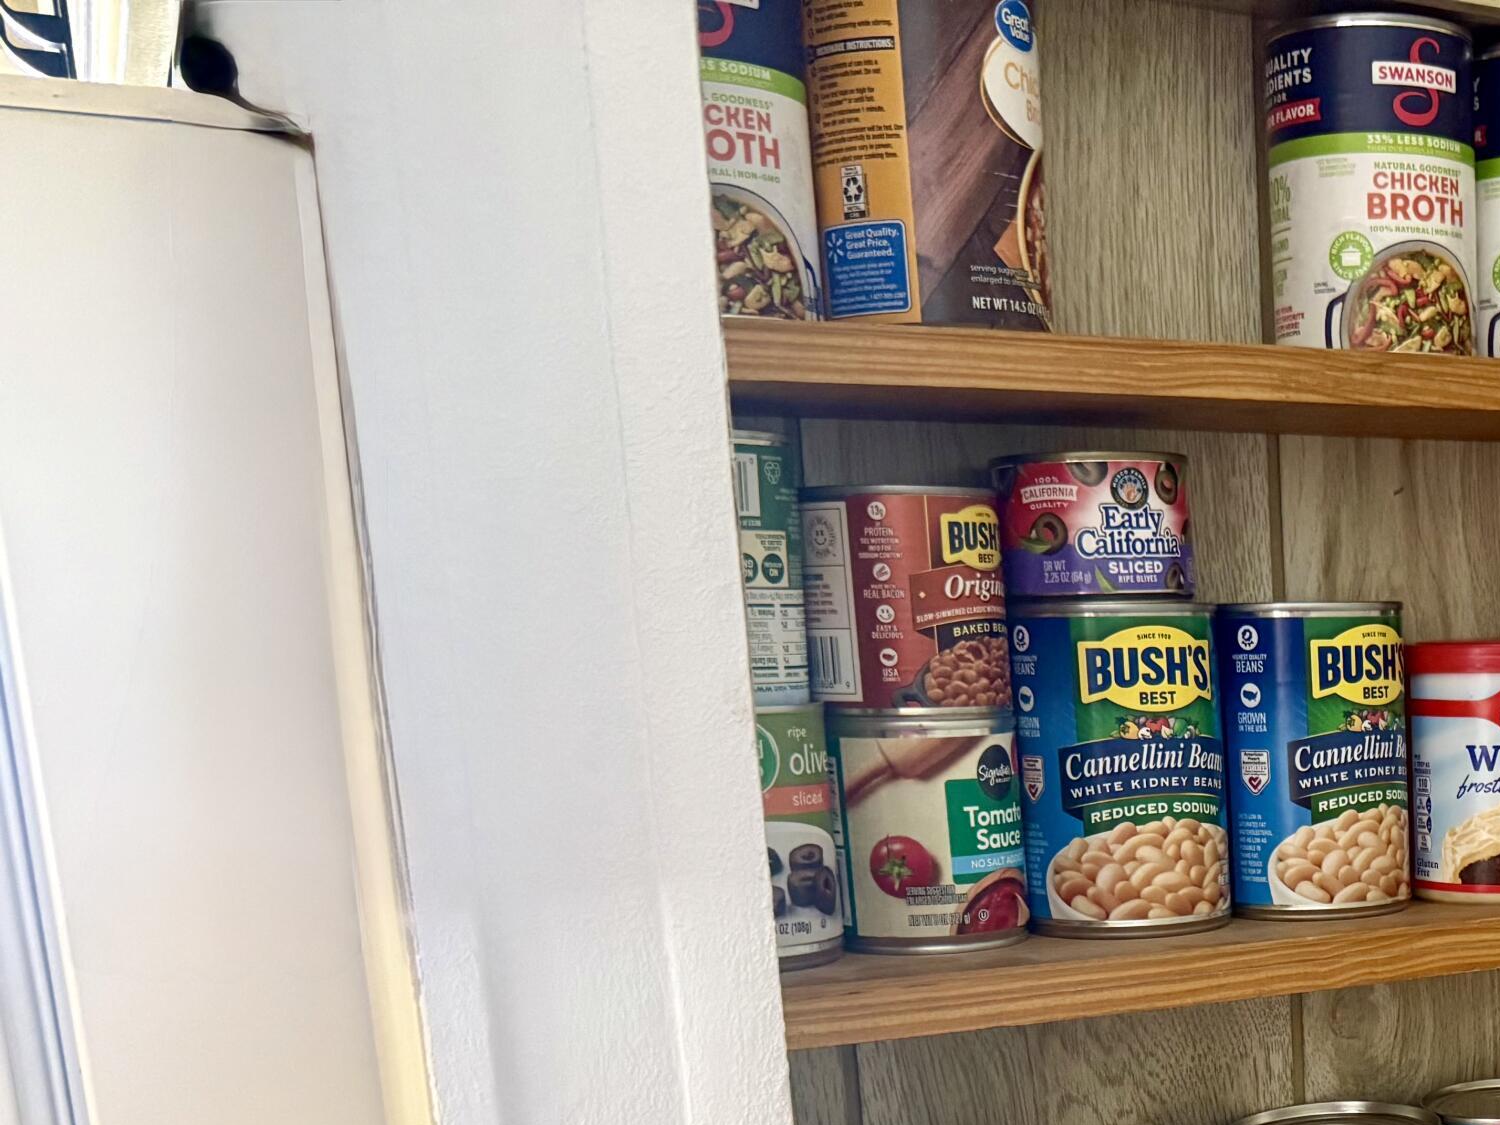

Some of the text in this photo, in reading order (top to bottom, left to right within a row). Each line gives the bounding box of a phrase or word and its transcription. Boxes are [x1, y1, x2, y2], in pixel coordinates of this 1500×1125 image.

[1001, 7, 1030, 31] Great
[720, 61, 772, 80] SODIUM
[1378, 66, 1453, 89] SWANSON
[1367, 134, 1393, 145] 33%
[1397, 136, 1424, 146] LESS
[1427, 138, 1461, 152] SODIUM
[1374, 161, 1418, 172] NATURAL
[1373, 171, 1459, 196] CHICKEN
[1366, 192, 1463, 228] BROTH
[972, 295, 990, 310] NET
[993, 298, 1008, 311] WT
[1023, 487, 1075, 500] CALIFORNIA
[1029, 502, 1069, 511] QUALITY
[1101, 505, 1163, 537] Early
[864, 527, 894, 537] PROTEIN
[1075, 528, 1179, 557] California
[978, 553, 995, 564] BEST
[1109, 561, 1164, 574] SLICED
[1118, 574, 1158, 583] RIPE OLIVES
[953, 622, 991, 637] BAKED
[882, 668, 899, 677] USA
[1085, 645, 1210, 695] BUSH'S
[1236, 660, 1264, 673] BEANS
[1139, 691, 1177, 706] BEST
[1362, 685, 1389, 700] BEST
[1237, 712, 1267, 724] GROWN
[787, 727, 807, 742] ripe
[790, 745, 829, 776] olive
[1294, 733, 1394, 773] Cannellini
[1066, 743, 1185, 781] Cannellini
[1299, 765, 1396, 789] WHITE KIDNEY
[1070, 781, 1124, 799] WHITE
[1130, 776, 1189, 790] KIDNEY
[792, 792, 823, 807] sliced
[1318, 790, 1383, 813] REDUCED
[1090, 802, 1169, 824] REDUCED
[976, 828, 1021, 851] Sauce
[970, 857, 1005, 869] NO SALT
[1416, 859, 1439, 870] Gluten
[1416, 868, 1431, 877] Free
